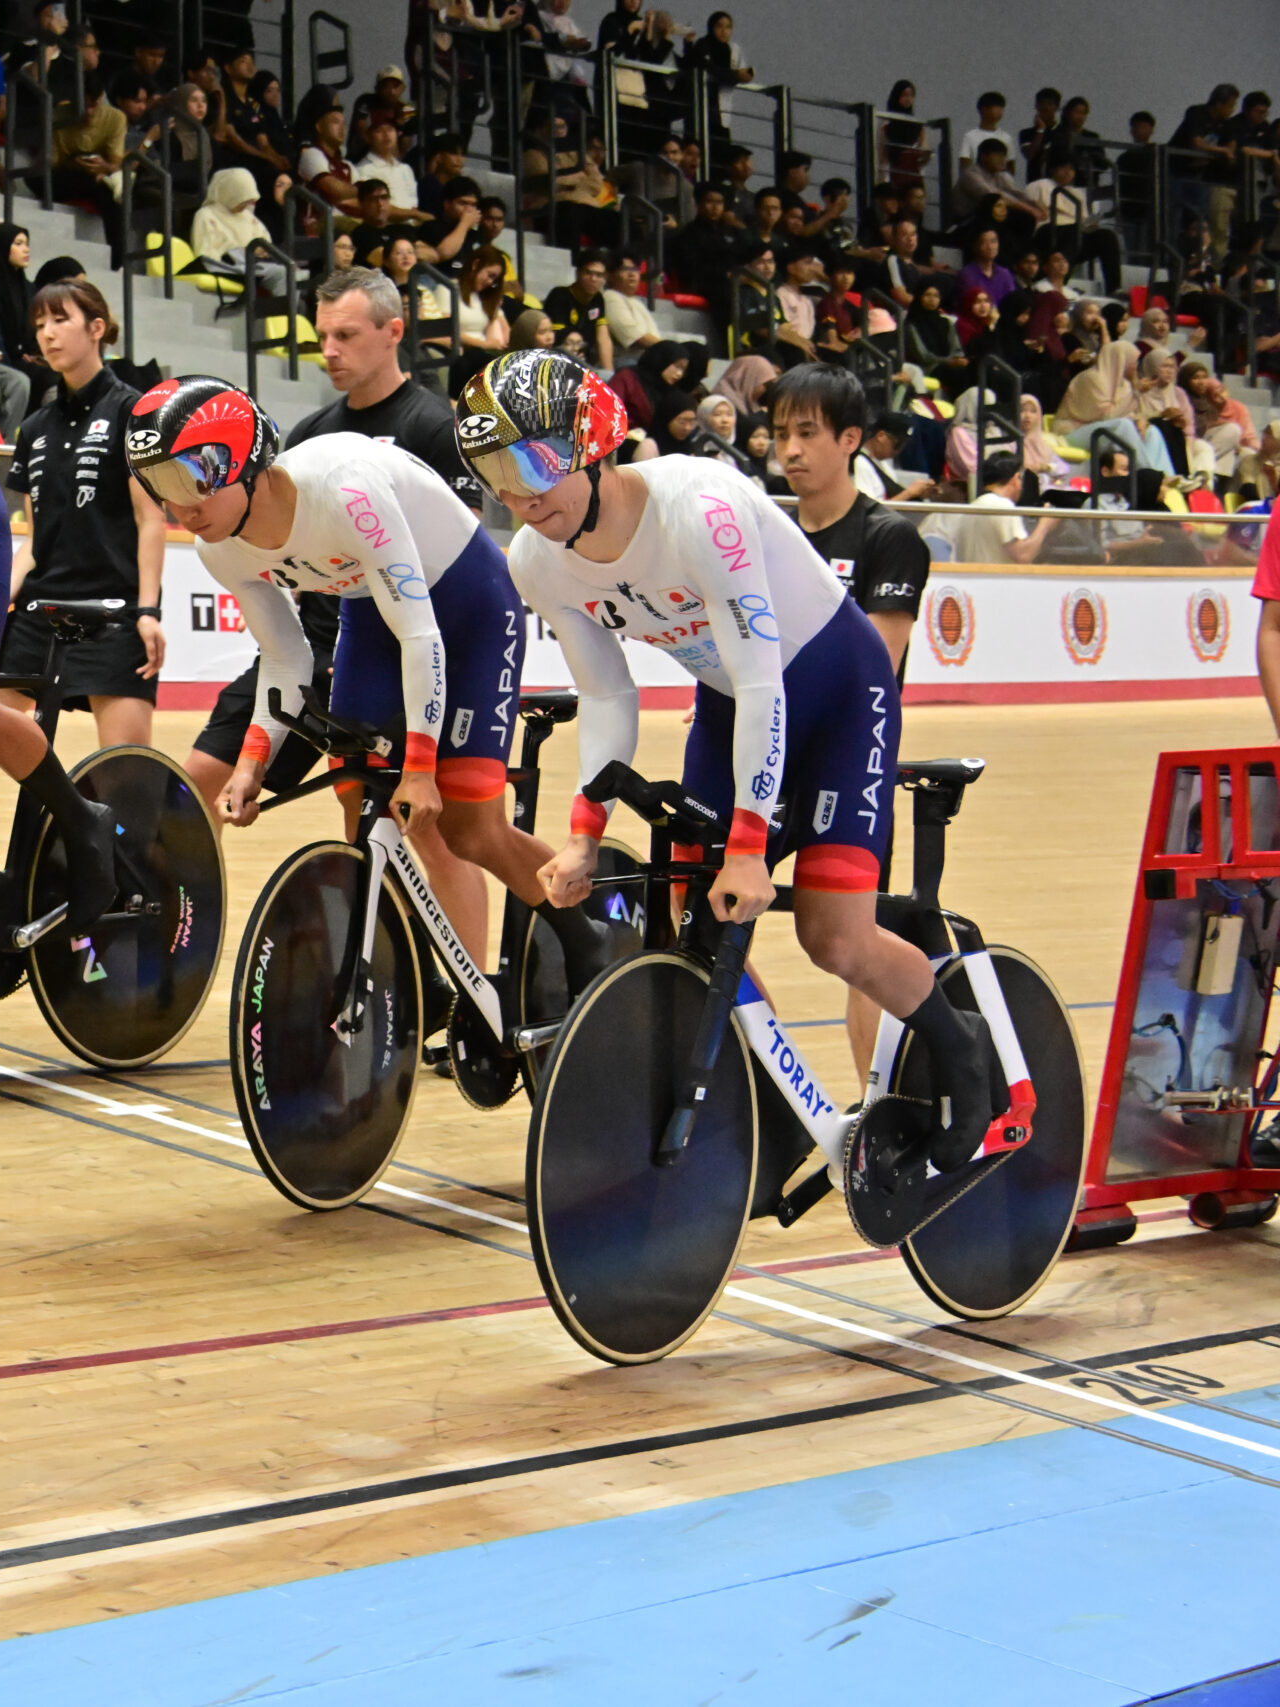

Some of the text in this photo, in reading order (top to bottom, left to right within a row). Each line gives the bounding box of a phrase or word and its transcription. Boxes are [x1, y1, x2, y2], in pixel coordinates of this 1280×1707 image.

[462, 434, 500, 449] Kabuto
[727, 599, 750, 640] KEIRIN
[432, 641, 443, 696] Cyclers
[490, 610, 517, 748] JAPAN
[766, 696, 781, 767] Cyclers
[858, 686, 886, 835] JAPAN
[684, 796, 718, 820] aerocoach
[394, 843, 486, 992] BRIDGESTONE
[251, 936, 275, 1110] ARAYA JAPAN
[382, 989, 394, 1070] JAPAN SL
[1069, 1364, 1225, 1406] 240
